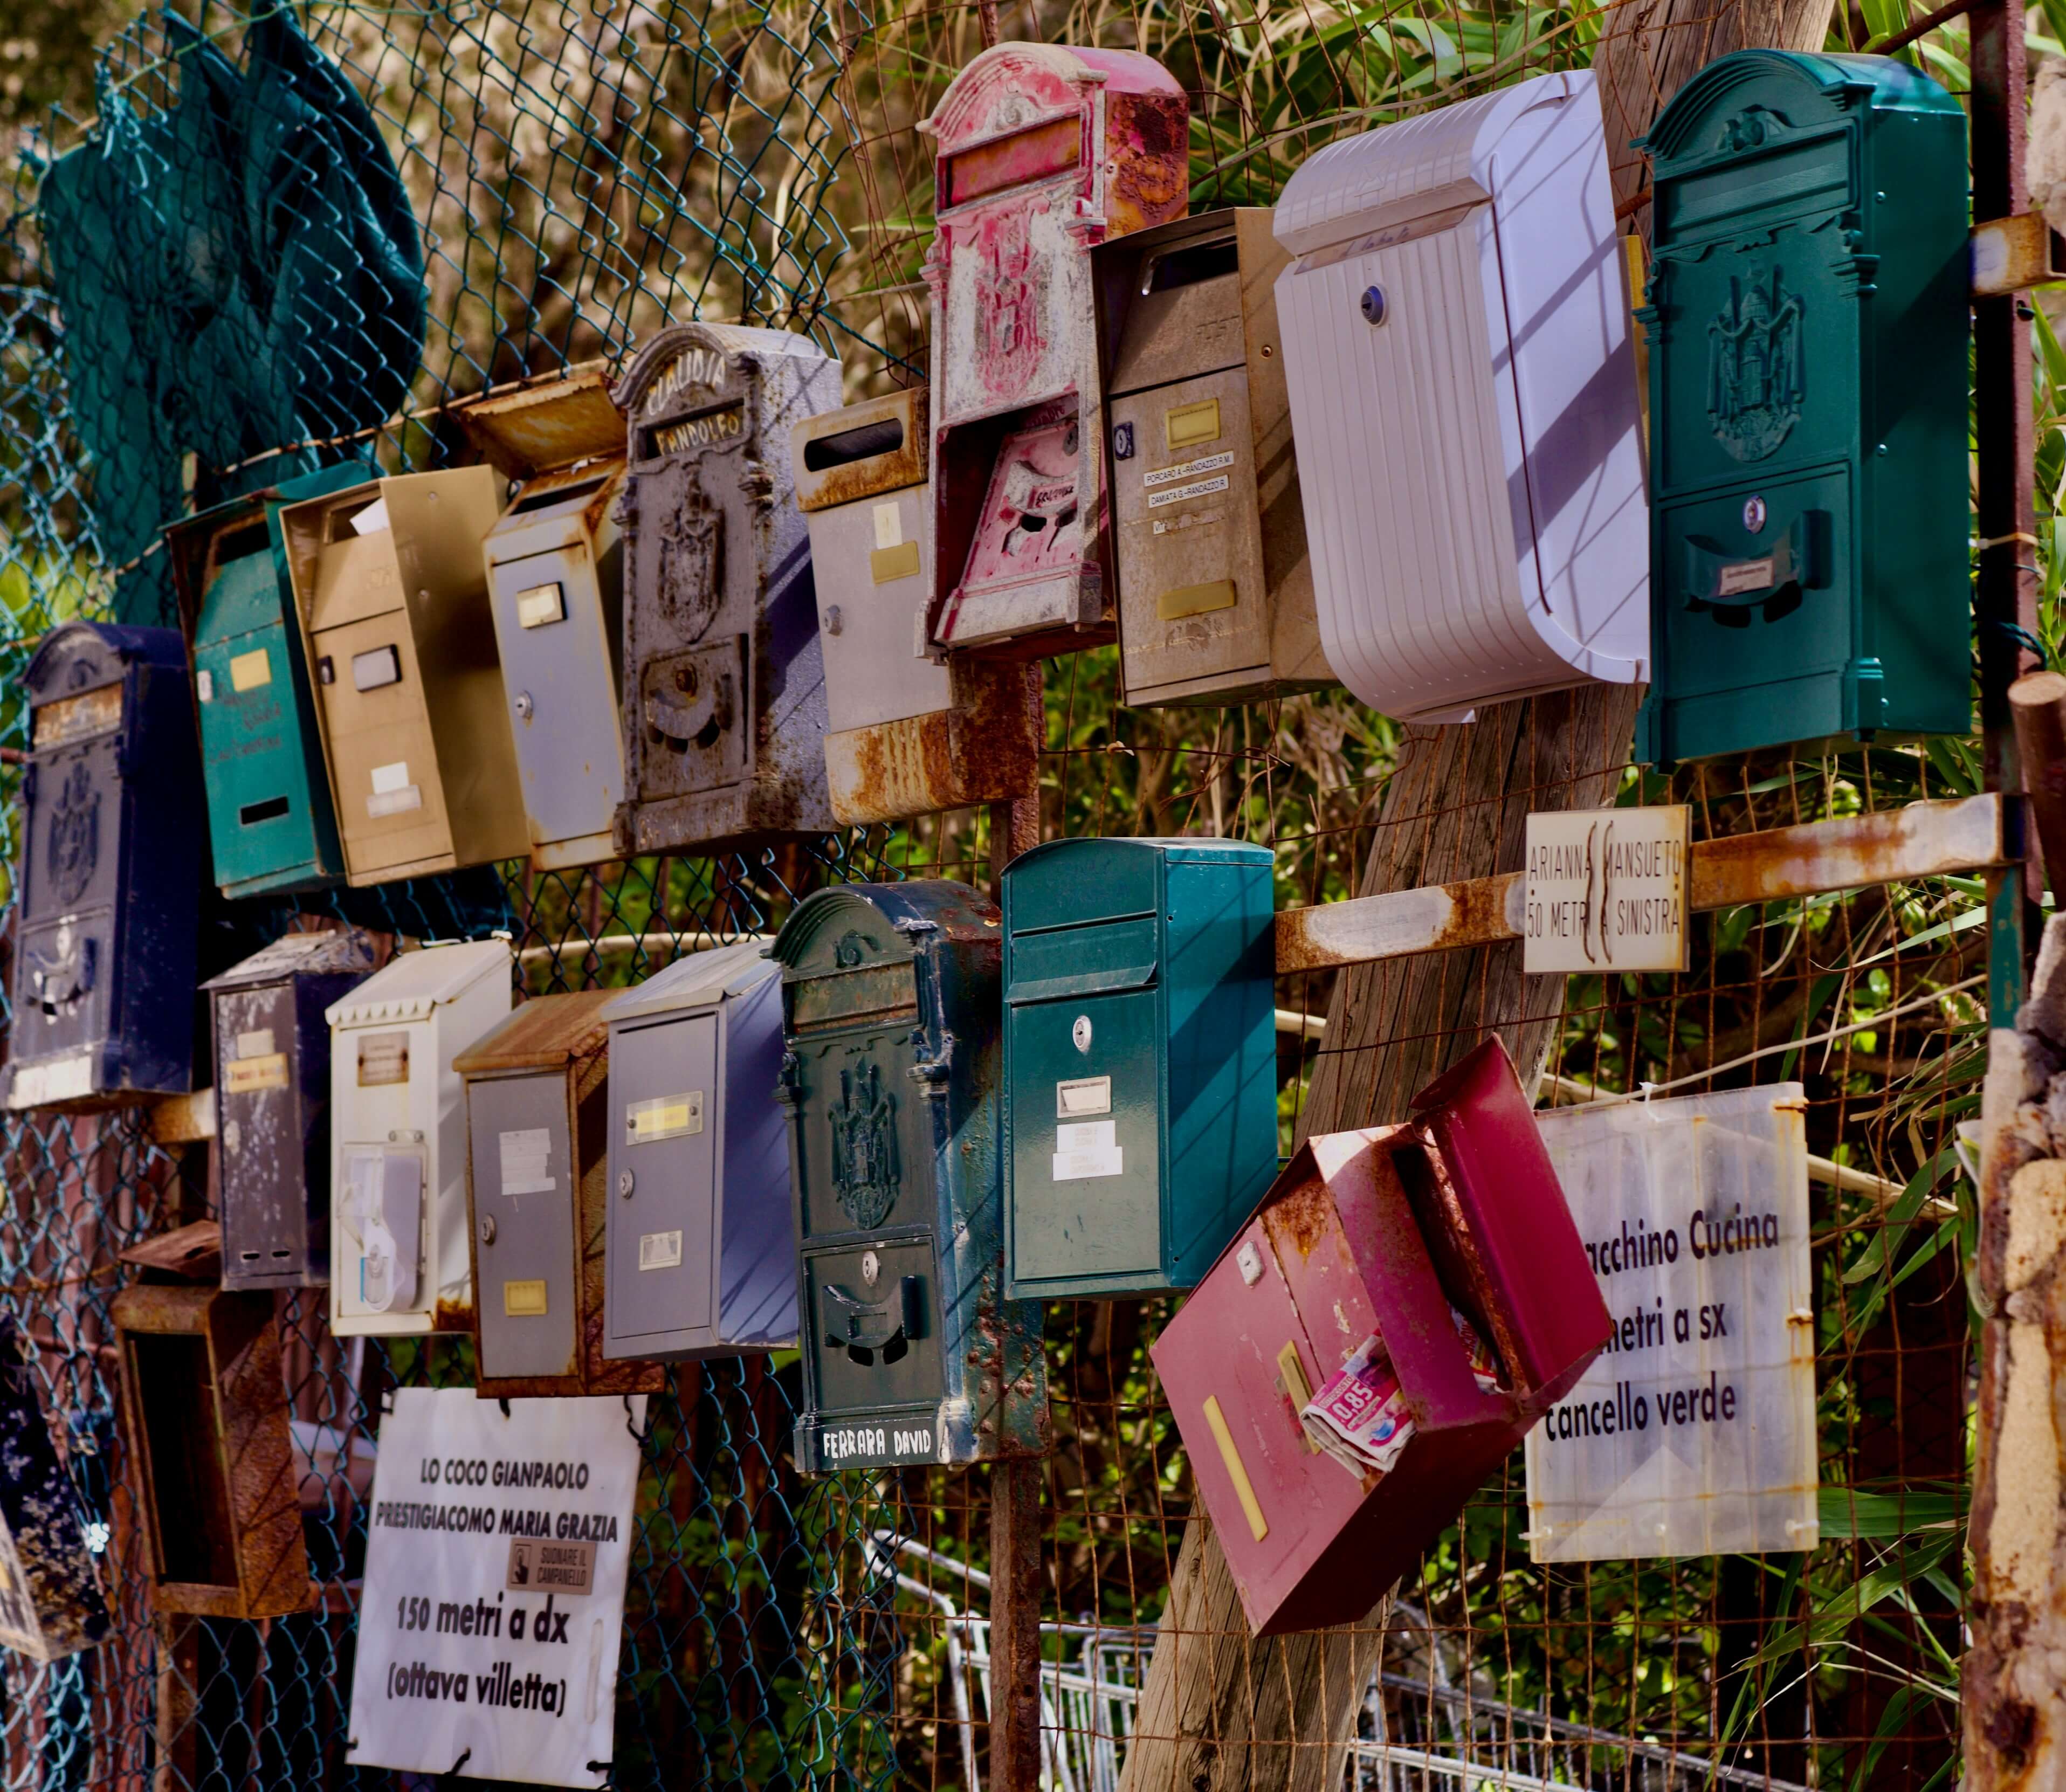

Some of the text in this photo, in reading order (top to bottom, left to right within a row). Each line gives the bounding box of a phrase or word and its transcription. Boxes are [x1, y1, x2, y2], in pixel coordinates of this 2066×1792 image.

[648, 348, 725, 416] CLAUDIA
[1527, 902, 1542, 938] 50
[1617, 898, 1679, 935] SINISTRA
[1690, 1203, 1778, 1260] Cucina
[1674, 1307, 1690, 1342] a
[1699, 1303, 1727, 1340] sx
[1332, 1382, 1373, 1419] 0,85
[1545, 1371, 1736, 1442] cancello verde
[823, 1429, 931, 1459] FERRARA DAVID
[421, 1459, 589, 1490] LO COCO GIANPAOLO
[375, 1502, 618, 1542] PRESTIGIACOMO MARIA GRAZIA
[537, 1567, 587, 1587] CAMPANELLO
[398, 1593, 569, 1644] 150 metri a dx
[387, 1662, 567, 1717] (ottava villetta)
